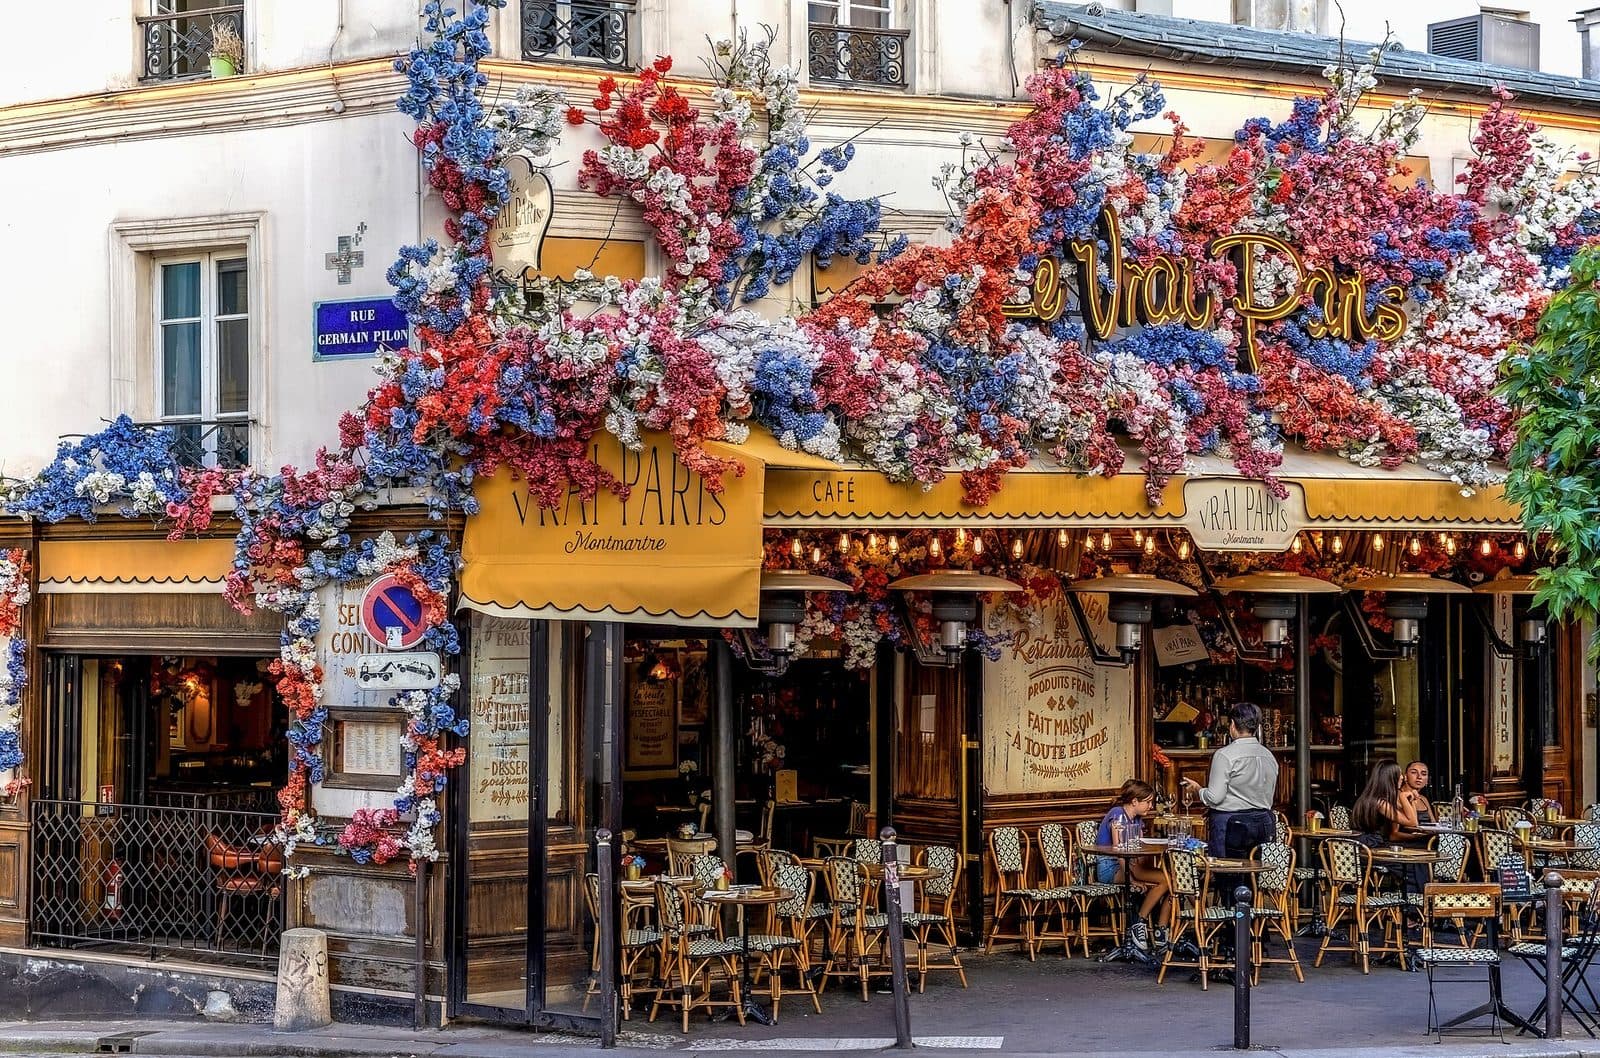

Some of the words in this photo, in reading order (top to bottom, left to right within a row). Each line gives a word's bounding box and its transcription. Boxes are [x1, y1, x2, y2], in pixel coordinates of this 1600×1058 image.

[1066, 203, 1214, 340] Vrai
[1210, 233, 1408, 374] Paris
[350, 309, 375, 322] RUE
[318, 331, 369, 345] GERMAIN
[373, 329, 408, 342] PILON
[621, 441, 727, 526] PARIS
[813, 476, 855, 503] CAFÉ
[1199, 486, 1239, 531] VRAI
[1246, 486, 1288, 533] PARIS
[564, 530, 667, 554] Montmartre
[1222, 533, 1265, 546] Montmartre
[1027, 675, 1070, 701] PRODUITS
[1071, 676, 1096, 698] FRAIS
[1057, 695, 1066, 711] &
[1028, 709, 1053, 736] FAIT
[1054, 708, 1095, 737] MAISON
[1024, 736, 1067, 760] TOUTE
[1069, 726, 1110, 758] HEURE
